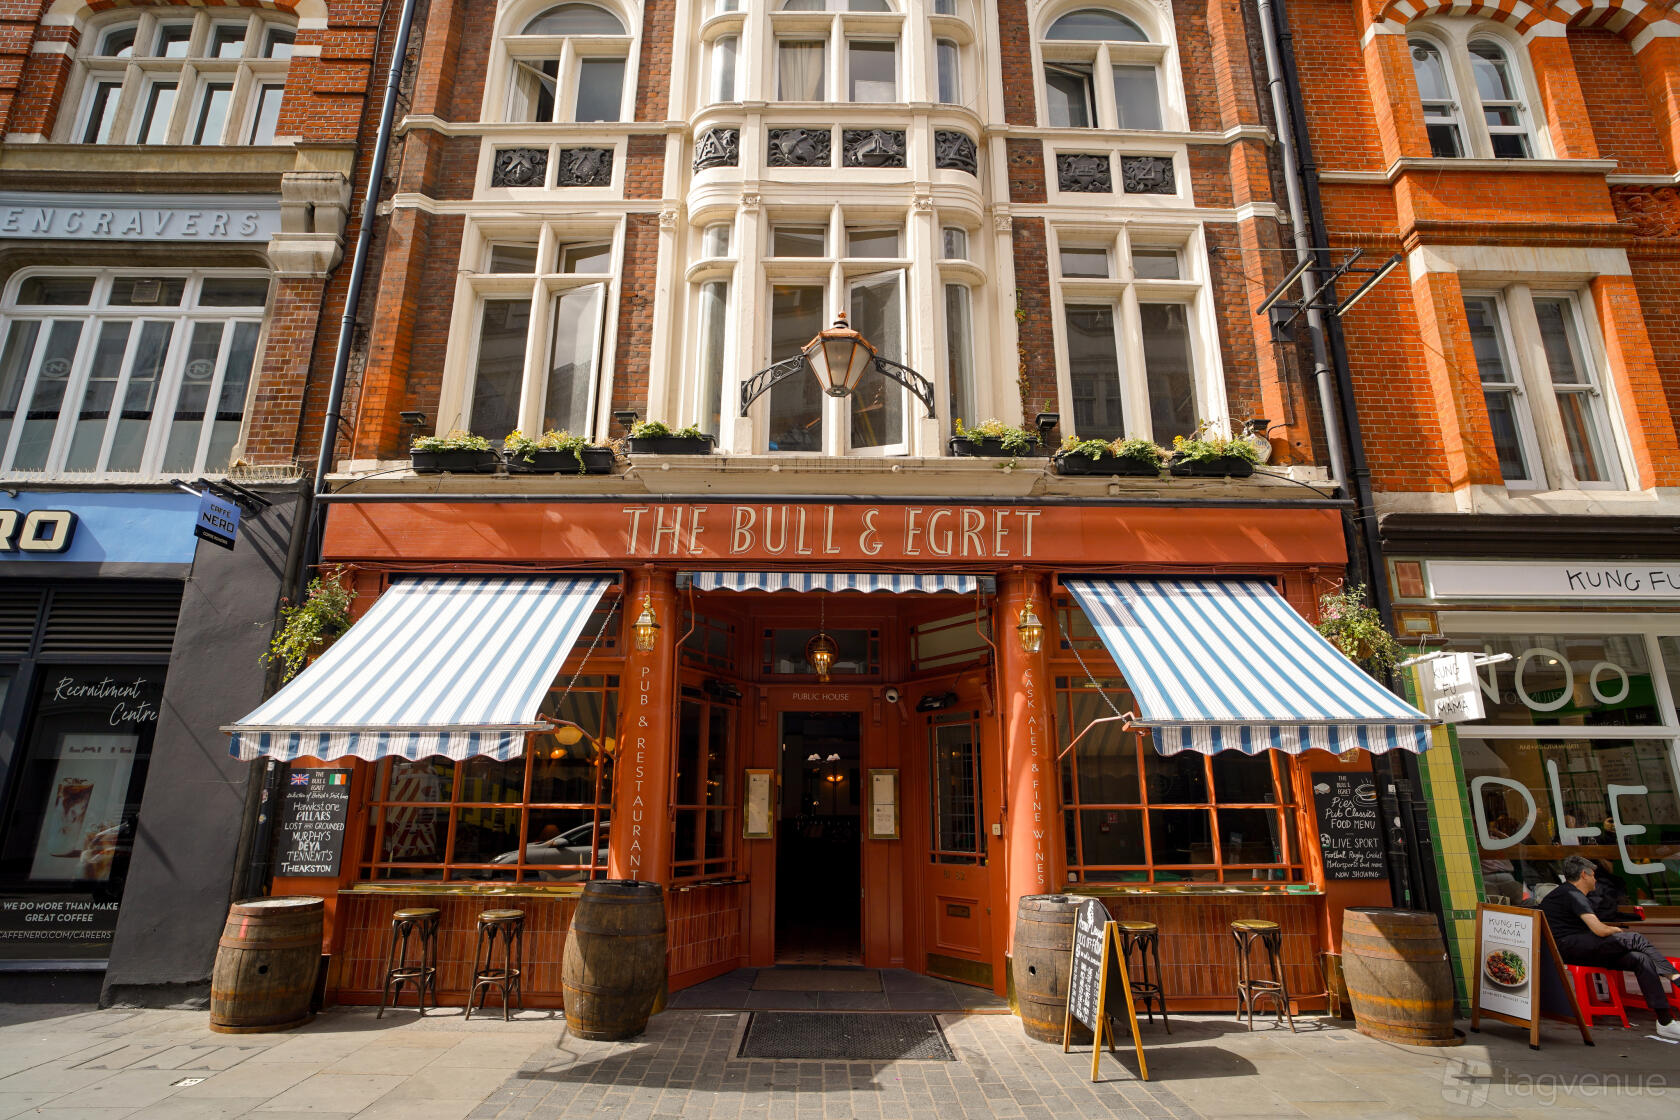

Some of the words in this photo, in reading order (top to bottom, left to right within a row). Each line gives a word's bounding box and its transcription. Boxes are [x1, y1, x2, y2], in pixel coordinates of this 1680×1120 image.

[1, 208, 259, 236] ENGRAVERS
[202, 511, 235, 533] NERO
[622, 505, 707, 556] THE
[729, 505, 841, 556] BULL
[859, 508, 884, 556] &
[904, 506, 1042, 557] EGRET
[1565, 569, 1641, 591] KUNG
[1648, 571, 1680, 591] FU
[1432, 662, 1460, 682] KUNG
[54, 676, 147, 701] Recruitment
[640, 666, 650, 706] PUB
[1024, 668, 1035, 708] CASK
[1443, 683, 1457, 696] FU
[792, 692, 819, 700] PUBLIC
[1437, 697, 1469, 716] MAMA
[109, 701, 158, 726] Centre
[638, 715, 648, 727] &
[1027, 715, 1037, 757] ALES
[1031, 763, 1040, 772] &
[293, 801, 341, 812] Hawkstone
[1032, 779, 1041, 822] FINE
[1331, 796, 1354, 808] Pies
[630, 737, 646, 880] RESTAURANT
[1325, 807, 1343, 820] Pub
[1344, 807, 1376, 818] Classics
[296, 811, 331, 821] PILLARS
[1471, 759, 1666, 875] DLE
[284, 822, 302, 830] LOST
[314, 822, 345, 831] GROUNDED
[1331, 819, 1351, 829] FOOD
[1353, 819, 1376, 829] MENU
[292, 831, 331, 841] MURPHY'S
[1332, 838, 1352, 849] LIVE
[1354, 838, 1379, 849] SPORT
[1032, 830, 1045, 885] WINES
[281, 862, 332, 873] THEAKSTON
[1351, 870, 1380, 878] SHOWING
[3, 902, 18, 911] WE
[19, 902, 34, 911] DO
[36, 902, 63, 911] MORE
[65, 902, 91, 911] THAN
[92, 902, 119, 911] MAKE
[25, 913, 56, 922] GREAT
[57, 913, 94, 922] COFFEE
[1488, 917, 1513, 929] KUNG
[1514, 920, 1527, 930] FU
[1493, 926, 1521, 938] MAMA
